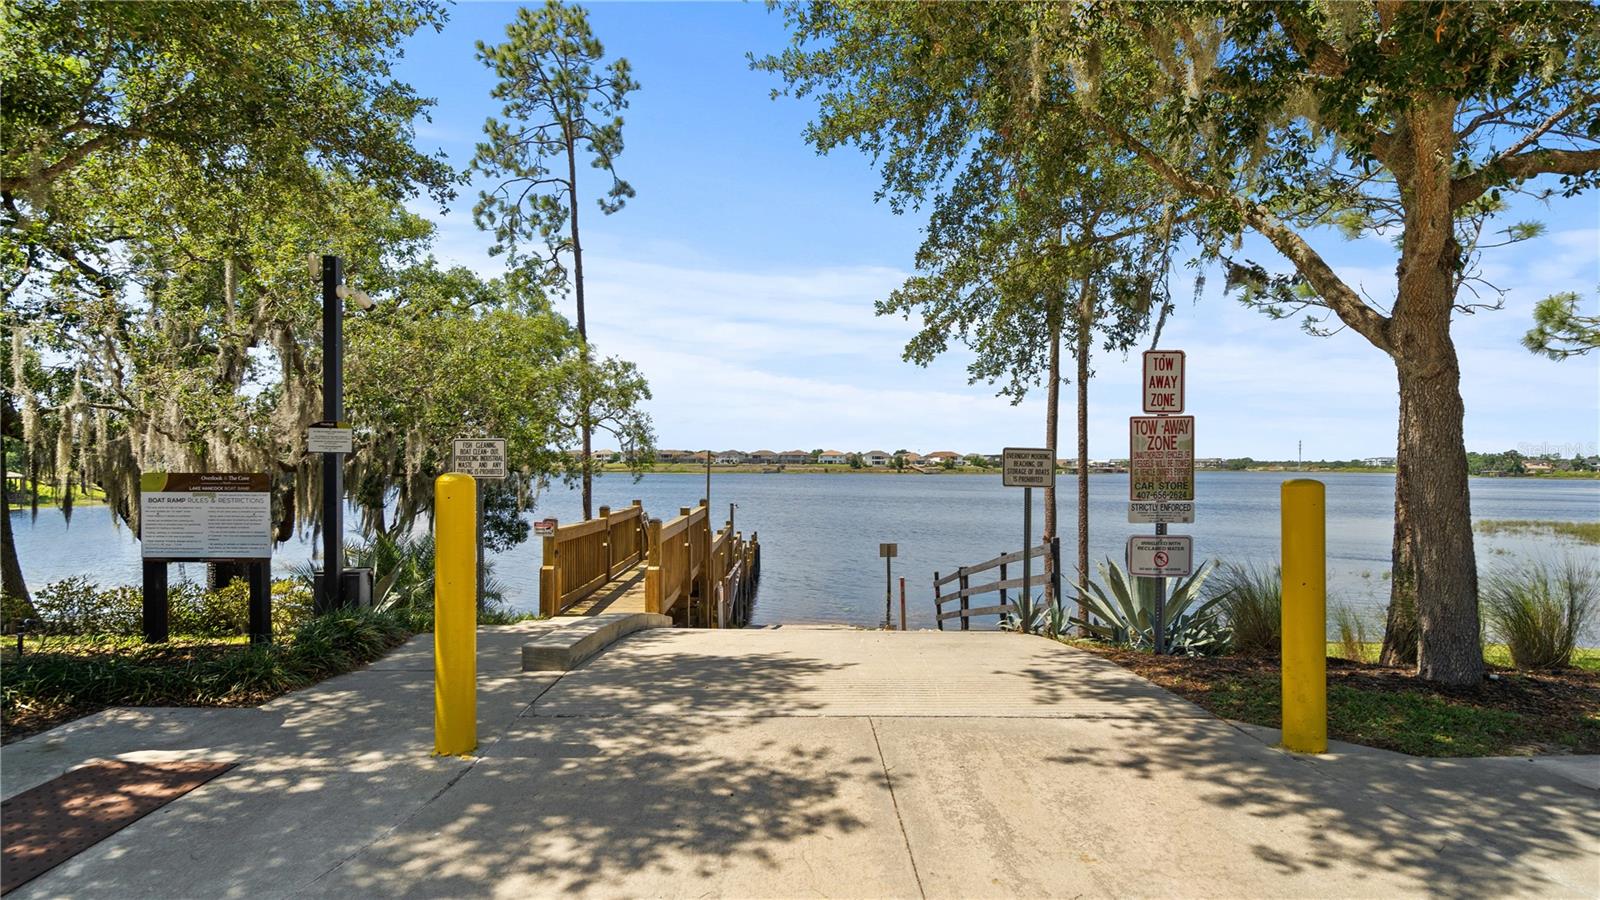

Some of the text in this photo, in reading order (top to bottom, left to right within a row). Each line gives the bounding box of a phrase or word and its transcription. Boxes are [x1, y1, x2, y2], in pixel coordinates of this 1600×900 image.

[1153, 357, 1174, 371] TOW
[1149, 375, 1178, 389] AWAY
[1150, 393, 1176, 407] ZONE
[1133, 419, 1190, 435] TOW AWAY
[1147, 435, 1178, 451] ZONE
[1134, 481, 1188, 490] CAR STORE
[1130, 503, 1191, 512] STRICTLY ENFORCED
